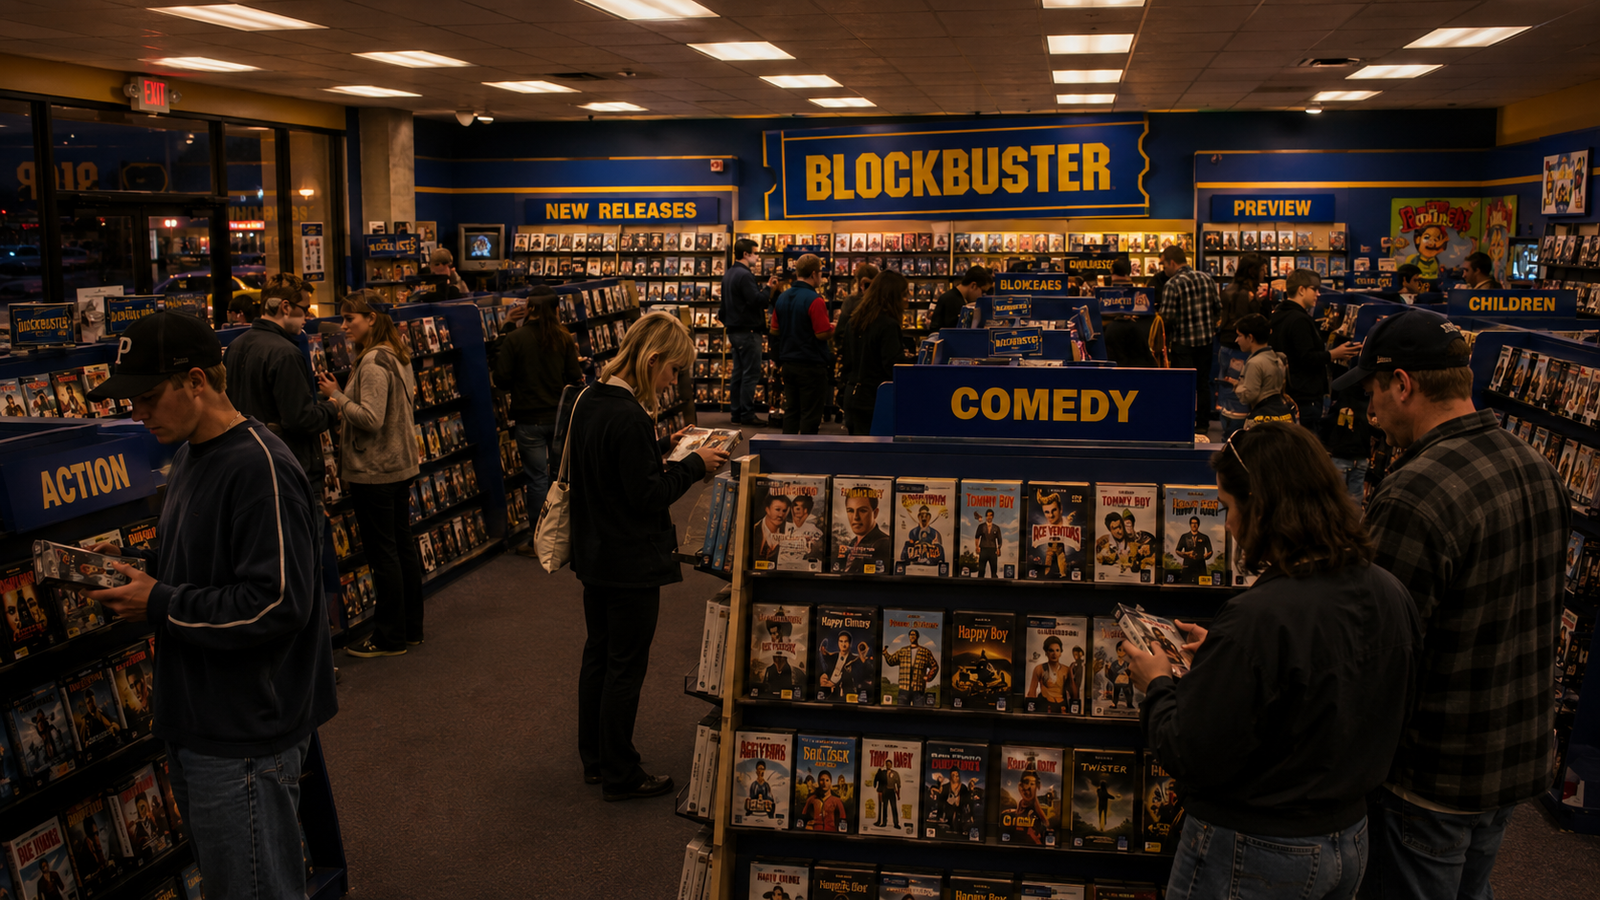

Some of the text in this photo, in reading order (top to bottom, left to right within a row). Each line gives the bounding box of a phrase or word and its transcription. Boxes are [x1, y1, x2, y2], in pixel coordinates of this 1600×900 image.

[144, 79, 165, 106] EXIT
[805, 142, 1111, 201] BLOCKBUSTER
[545, 202, 697, 220] NEW RELEASES
[1233, 200, 1312, 216] PREVIEW
[1469, 296, 1556, 312] CHILDREN
[115, 336, 132, 364] P
[951, 386, 1139, 423] COMEDY
[41, 453, 131, 510] ACTION
[1102, 495, 1151, 507] TOMMY BOY
[958, 624, 1009, 643] Happy Boy
